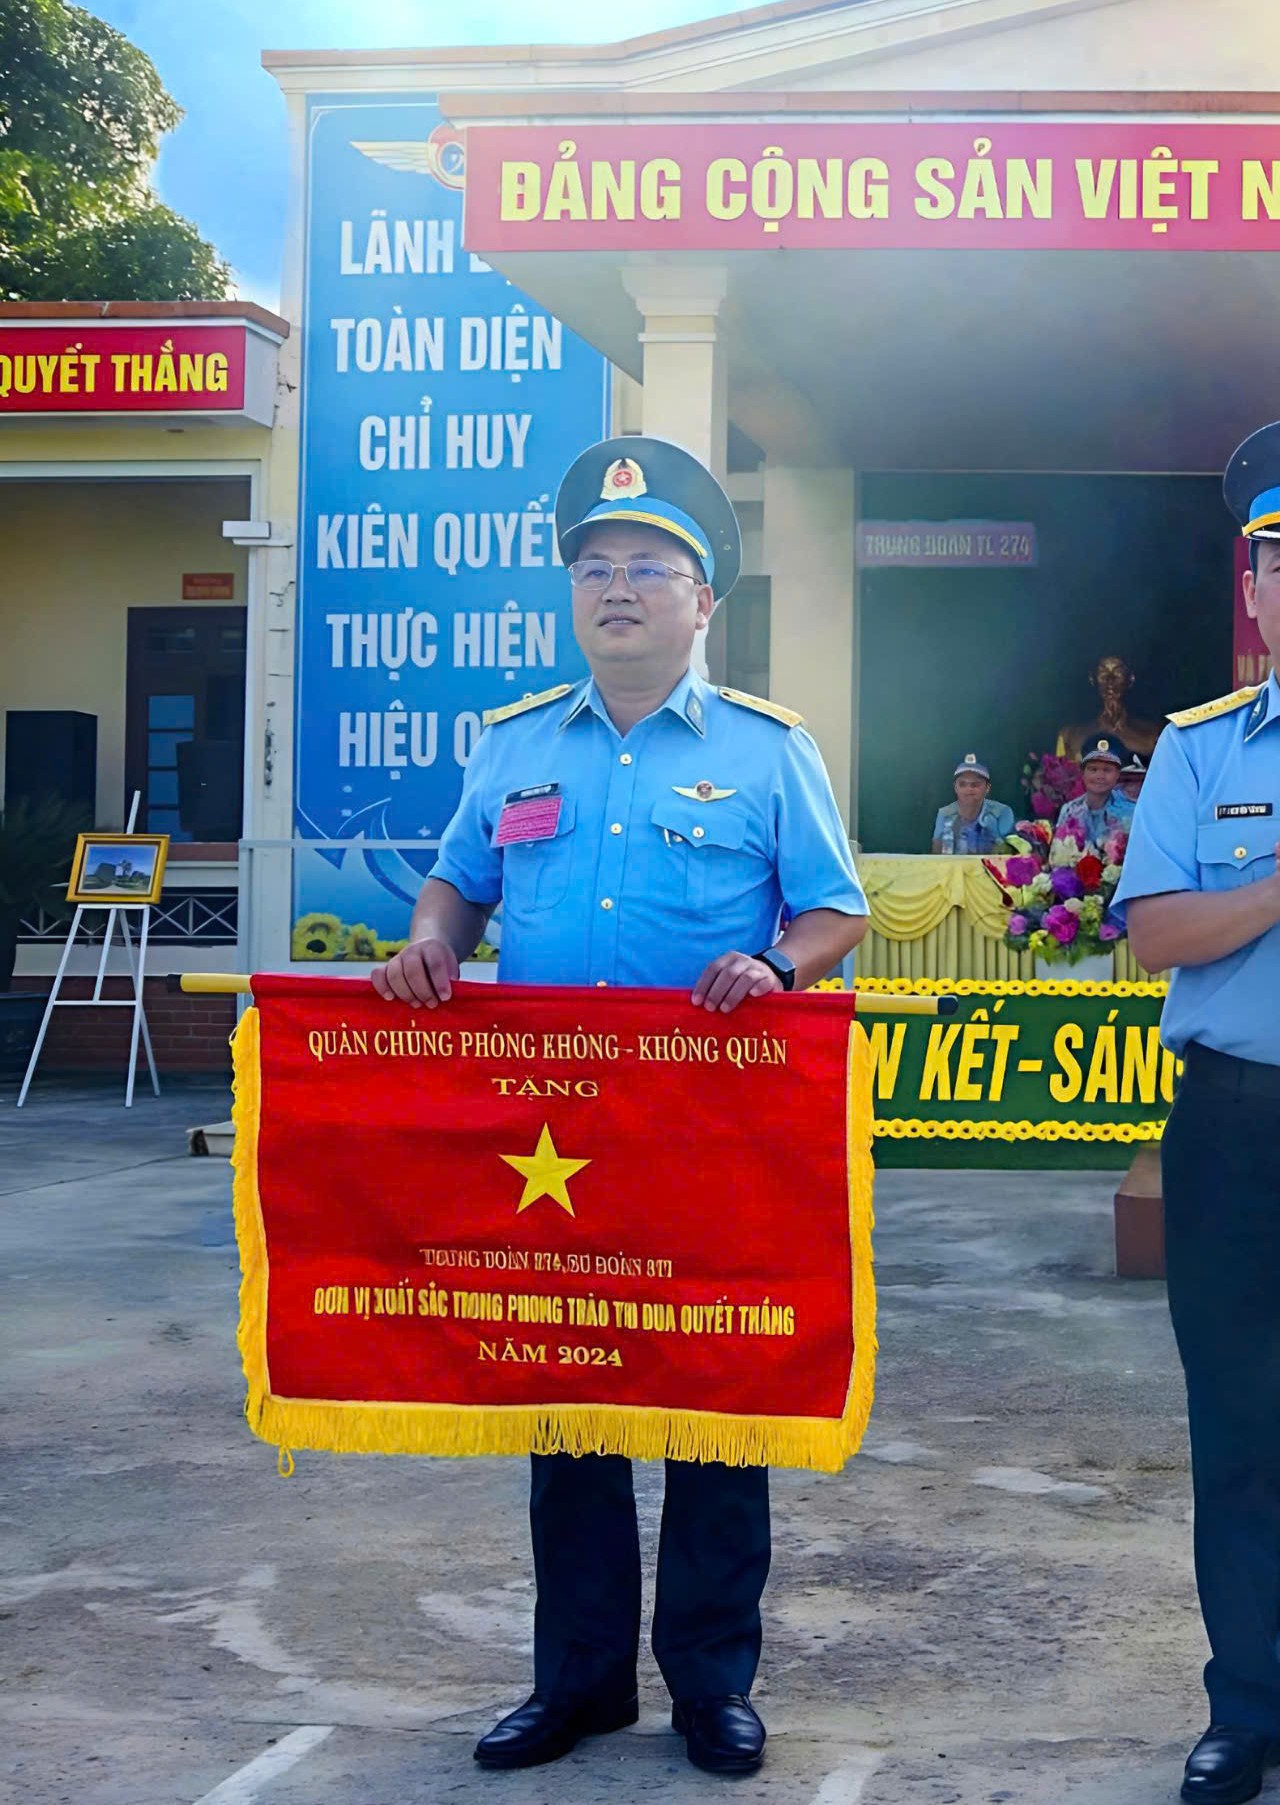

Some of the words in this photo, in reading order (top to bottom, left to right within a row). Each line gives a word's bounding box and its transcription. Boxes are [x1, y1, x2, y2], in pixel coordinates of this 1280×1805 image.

[498, 139, 682, 222] ĐẢNG
[706, 146, 890, 233] CỘNG
[914, 137, 1053, 220] SẢN
[1075, 146, 1219, 233] VIỆT
[340, 209, 455, 275] LÃNH
[111, 338, 229, 393] THẮNG
[330, 305, 445, 373] TOÀN
[459, 303, 563, 383] DIỆN
[359, 395, 433, 471] CHỈ
[446, 413, 532, 469] HUY
[317, 502, 419, 569] KIÊN
[326, 607, 439, 681] THỰC
[453, 600, 556, 681] HIỆN
[338, 698, 439, 780] HIỆU
[492, 1074, 600, 1101] TẶNG
[477, 1337, 548, 1364] NĂM
[557, 1345, 623, 1367] 2024
